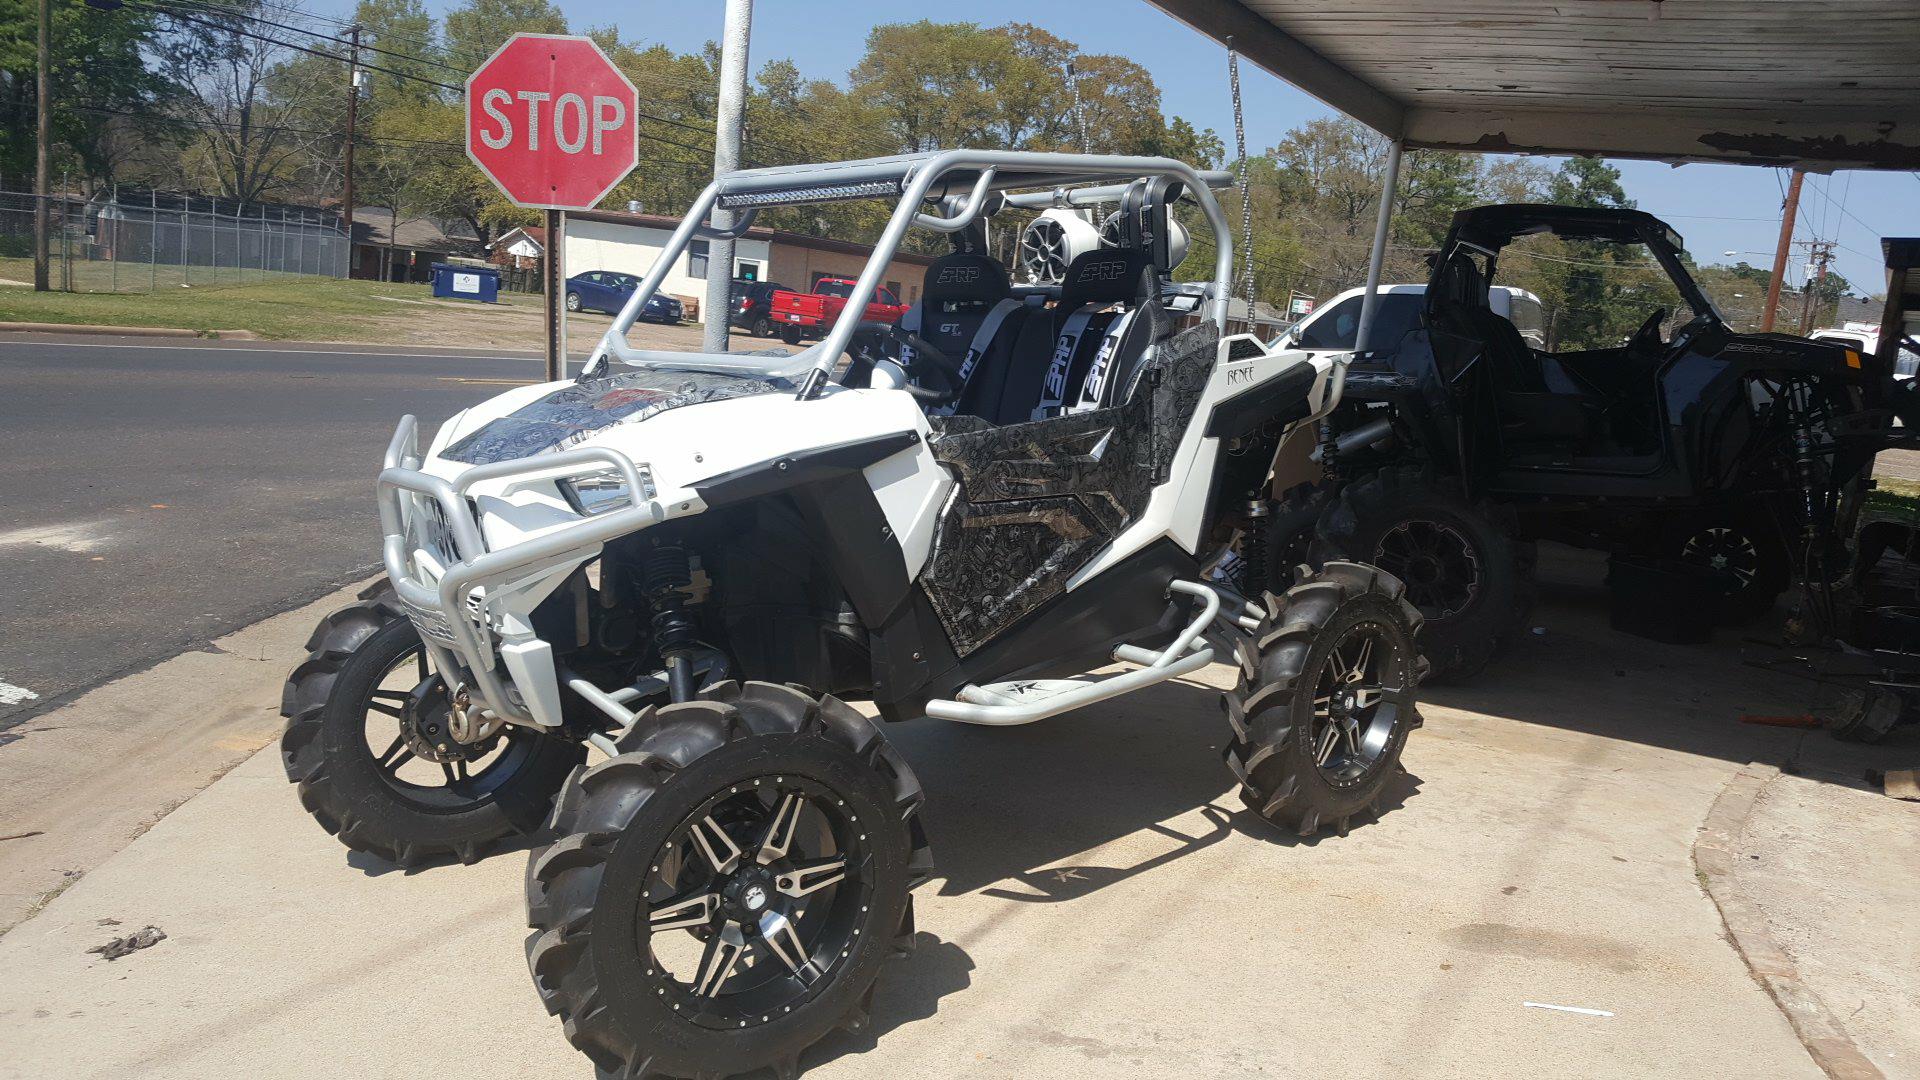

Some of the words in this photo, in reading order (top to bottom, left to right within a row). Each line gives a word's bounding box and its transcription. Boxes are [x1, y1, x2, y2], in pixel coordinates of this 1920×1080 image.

[479, 88, 626, 155] STOP
[937, 266, 980, 284] PRP
[1077, 261, 1127, 283] PRP
[940, 323, 960, 333] GT
